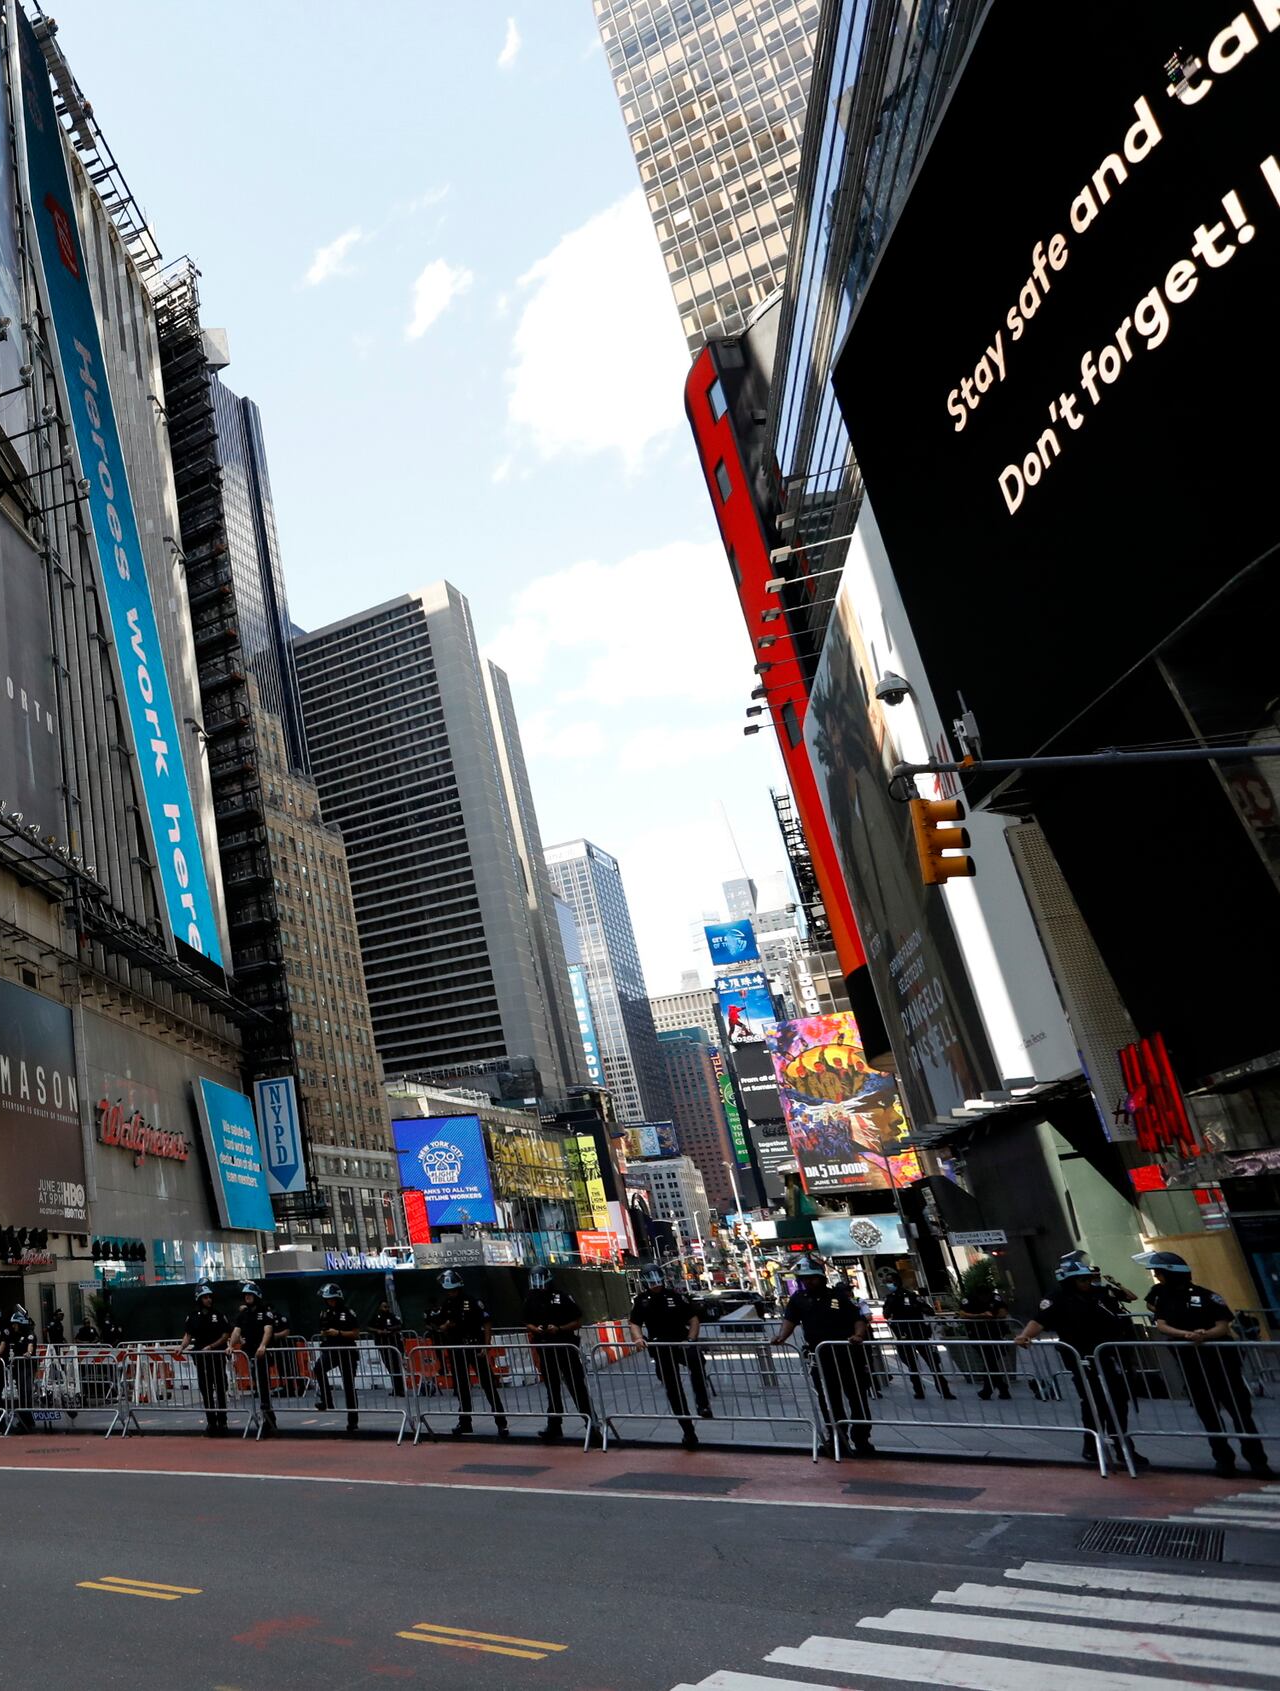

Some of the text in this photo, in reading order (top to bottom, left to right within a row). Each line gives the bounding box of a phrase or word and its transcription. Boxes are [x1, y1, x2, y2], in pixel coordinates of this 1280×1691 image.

[947, 331, 1006, 432] Stay
[1006, 232, 1068, 341] safe
[1070, 96, 1162, 234] and
[998, 189, 1255, 515] Don't forget!
[73, 337, 130, 582] Heroes
[125, 607, 170, 778] work
[798, 960, 820, 1014] 1500
[901, 976, 944, 1036] D'ANGELO
[570, 974, 599, 1085] TIMES SQU
[0, 1054, 78, 1113] MASON
[268, 1086, 288, 1164] NYPD
[418, 1146, 429, 1160] NEW
[450, 1144, 463, 1159] CITY
[758, 1141, 788, 1149] together
[38, 1179, 64, 1193] JUNE 21
[63, 1182, 85, 1207] HBO
[804, 1162, 869, 1178] DA 5 BLOODS
[39, 1192, 64, 1205] AT 9PM
[33, 1412, 60, 1420] POLICE
